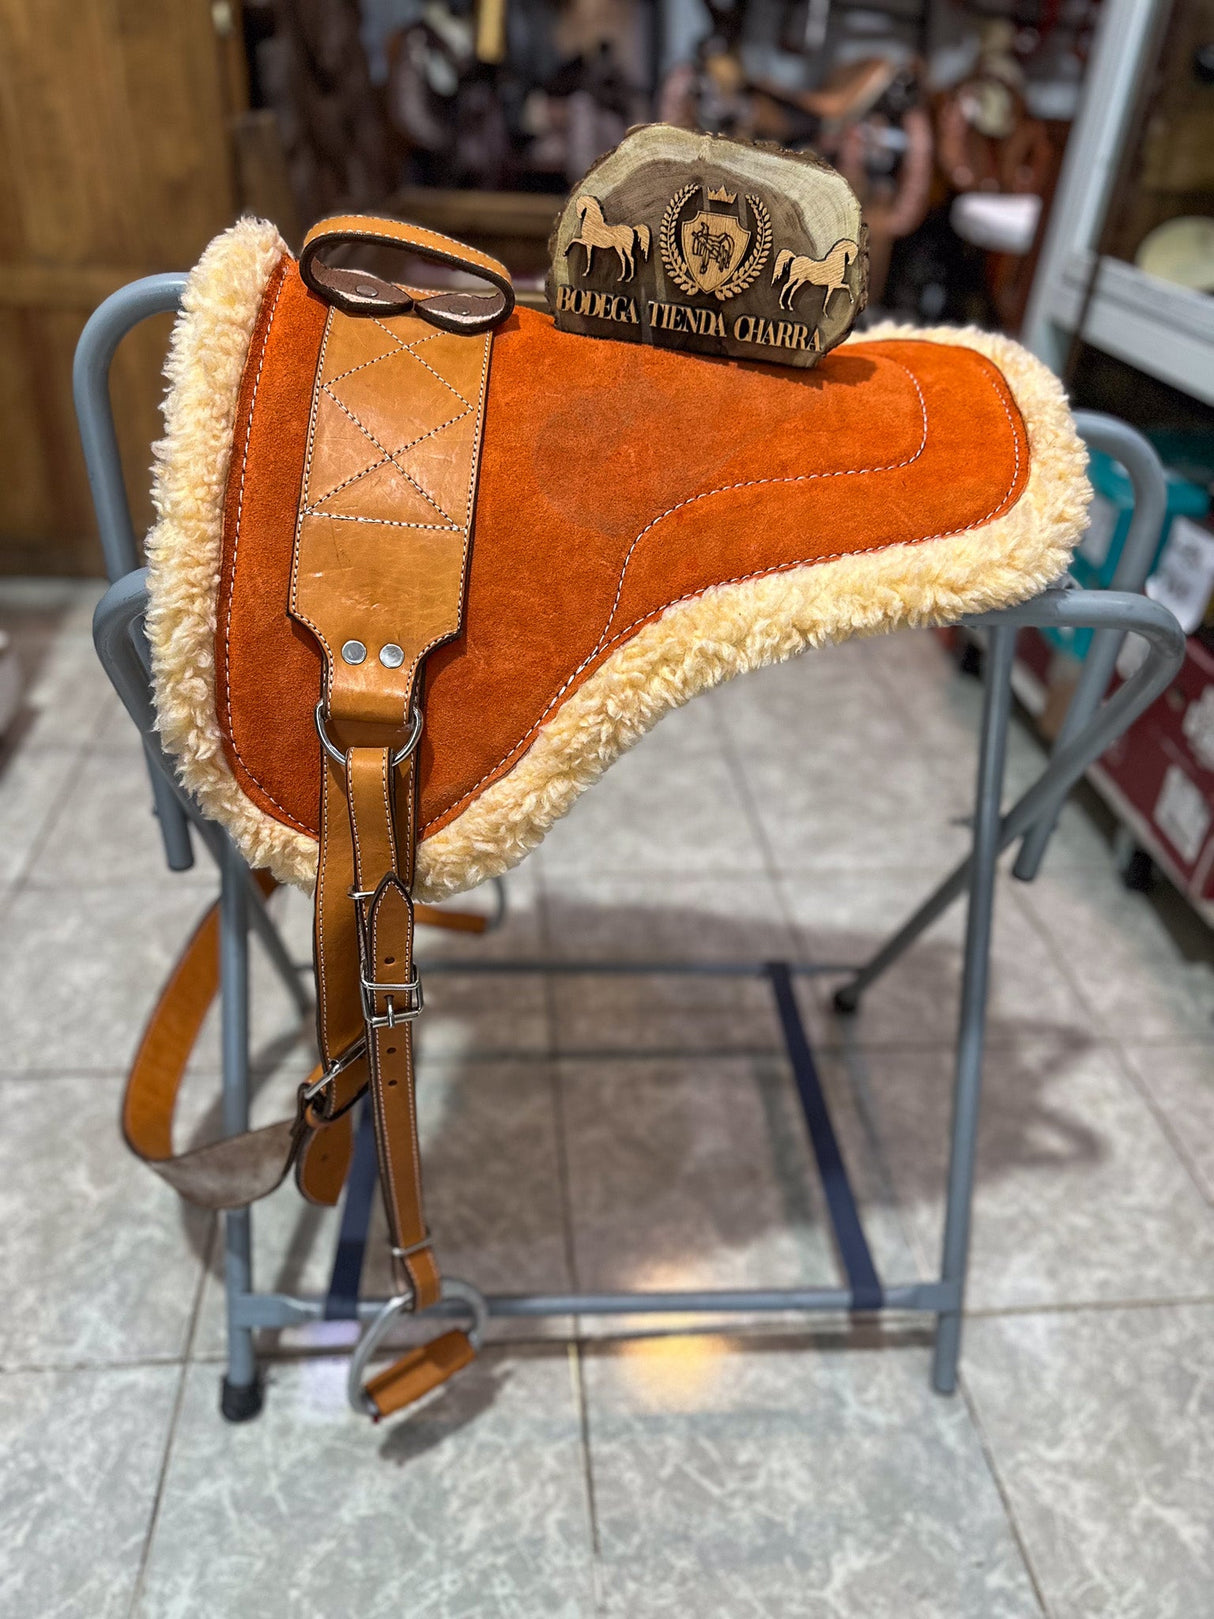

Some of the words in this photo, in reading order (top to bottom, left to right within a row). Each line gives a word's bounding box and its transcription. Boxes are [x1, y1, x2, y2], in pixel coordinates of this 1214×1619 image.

[556, 286, 640, 324] BODEGA
[648, 301, 727, 338] TIENDA
[734, 315, 822, 351] CHARRA
